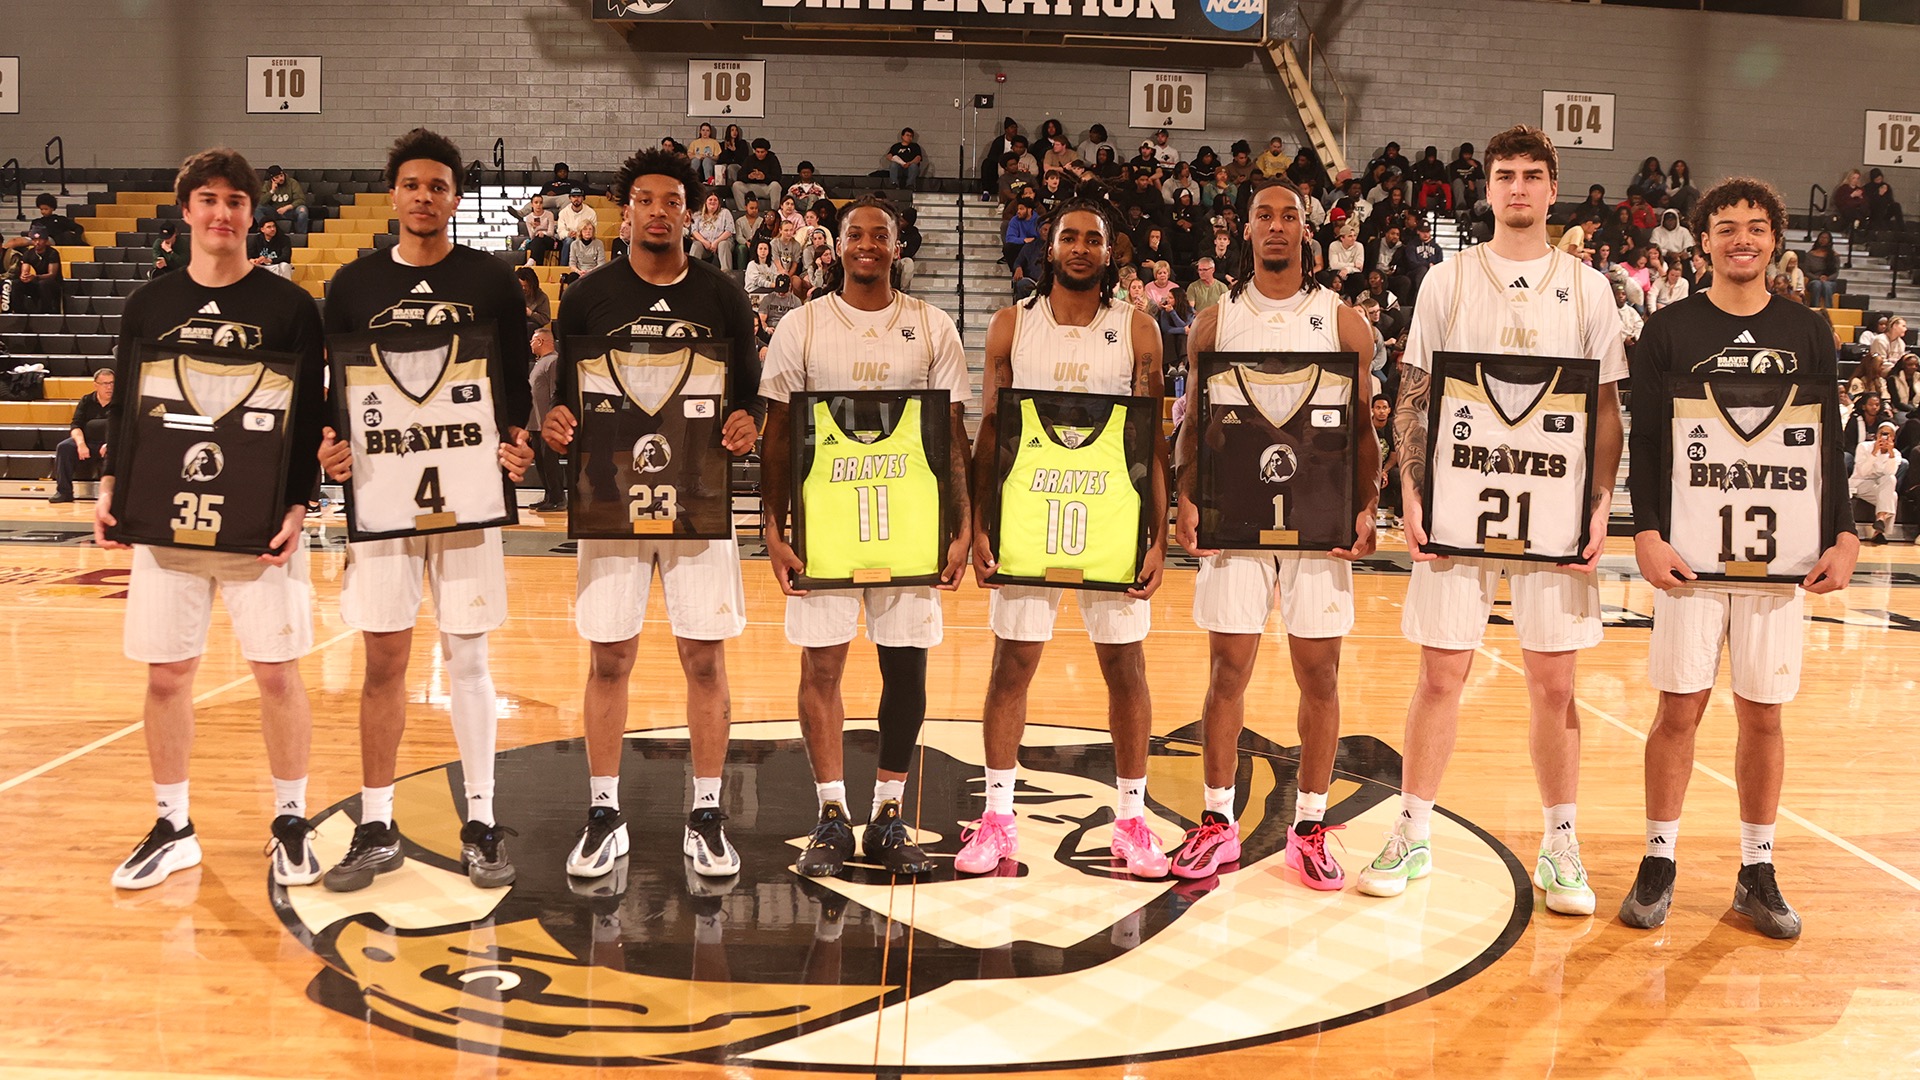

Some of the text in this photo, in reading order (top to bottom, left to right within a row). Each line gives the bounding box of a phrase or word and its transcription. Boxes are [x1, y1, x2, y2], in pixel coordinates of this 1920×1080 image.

[272, 59, 298, 67] SECTION
[713, 62, 741, 70] SECTION
[263, 69, 305, 98] 110
[702, 72, 751, 102] 108
[1155, 74, 1183, 82] SECTION
[1143, 83, 1193, 114] 106
[1566, 94, 1592, 102] SECTION
[1554, 103, 1602, 134] 104
[1878, 122, 1920, 153] 102
[392, 308, 425, 316] BRAVES
[631, 324, 664, 332] BRAVES
[1500, 327, 1539, 348] UNC
[852, 362, 890, 382] UNC
[1053, 362, 1090, 382] UNC
[364, 411, 381, 425] 24
[1454, 424, 1470, 438] 24
[1689, 445, 1705, 458] 24
[830, 453, 909, 483] BRAVES
[1029, 468, 1110, 495] BRAVES
[414, 466, 446, 513] 4
[628, 484, 677, 523] 23
[170, 491, 225, 532] 35
[855, 485, 890, 542] 11
[1272, 494, 1286, 530] 1
[1476, 488, 1532, 549] 21
[1046, 499, 1088, 556] 10
[1718, 505, 1777, 564] 13
